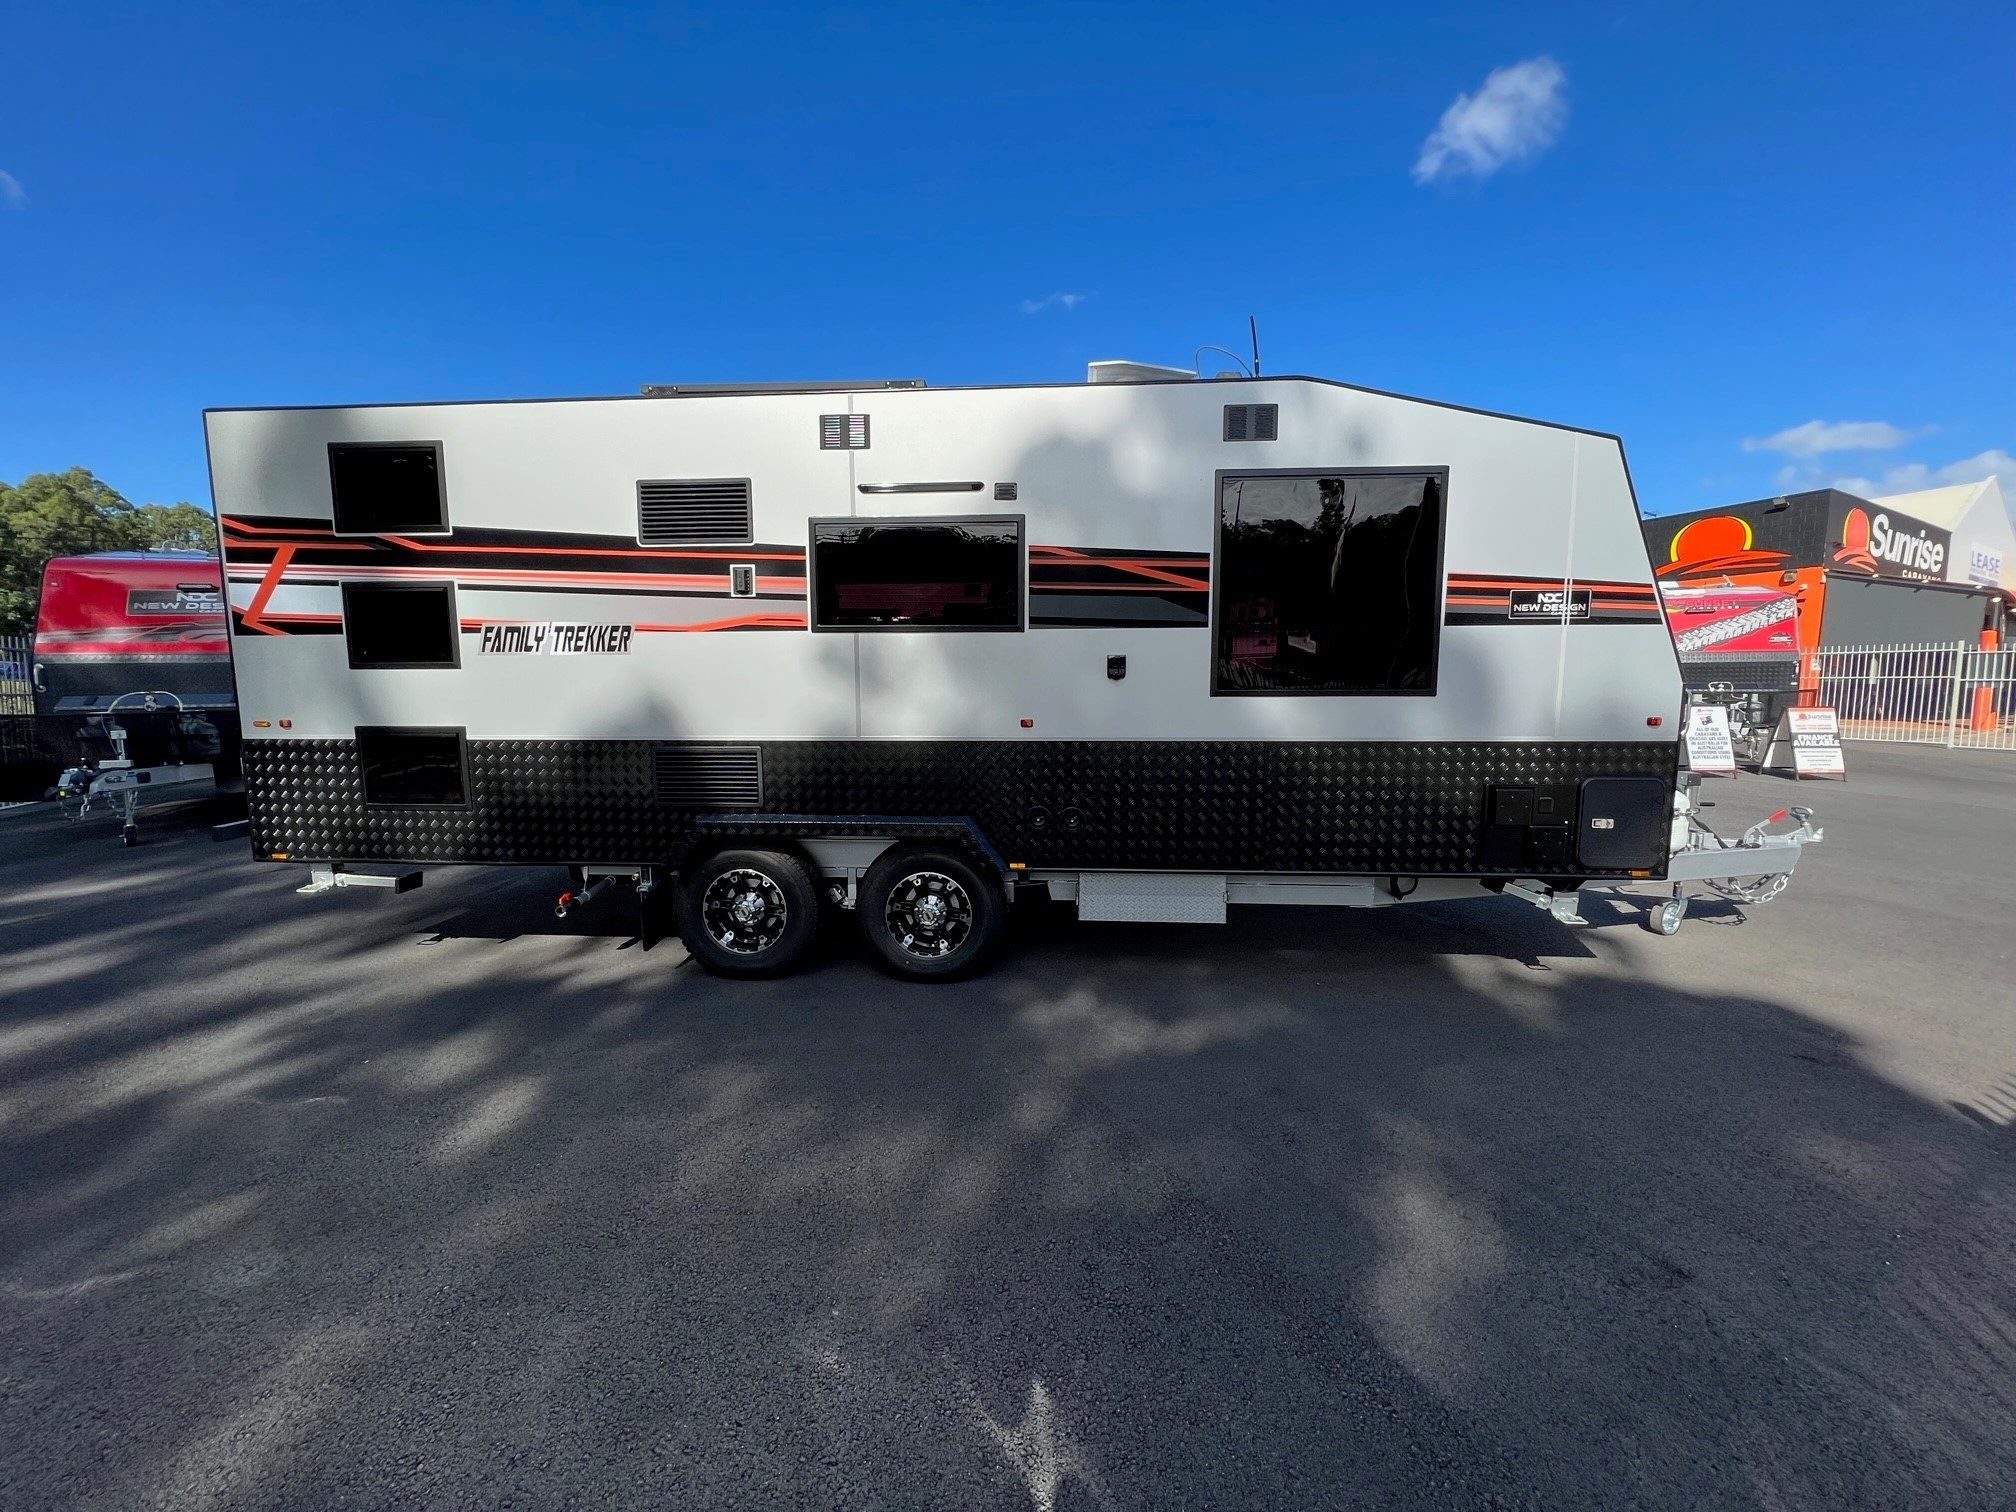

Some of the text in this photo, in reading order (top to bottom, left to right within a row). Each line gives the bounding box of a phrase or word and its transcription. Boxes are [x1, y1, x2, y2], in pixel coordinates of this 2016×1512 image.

[1869, 513, 1945, 573] Sunrise
[1971, 551, 2001, 574] LEASE
[176, 592, 218, 602] NDC
[1537, 592, 1564, 603] NDC
[133, 602, 179, 610] NEW
[1513, 603, 1540, 612] NEW
[481, 625, 633, 653] FAMILY TREKKER
[1793, 739, 1840, 747] AVAILABLE
